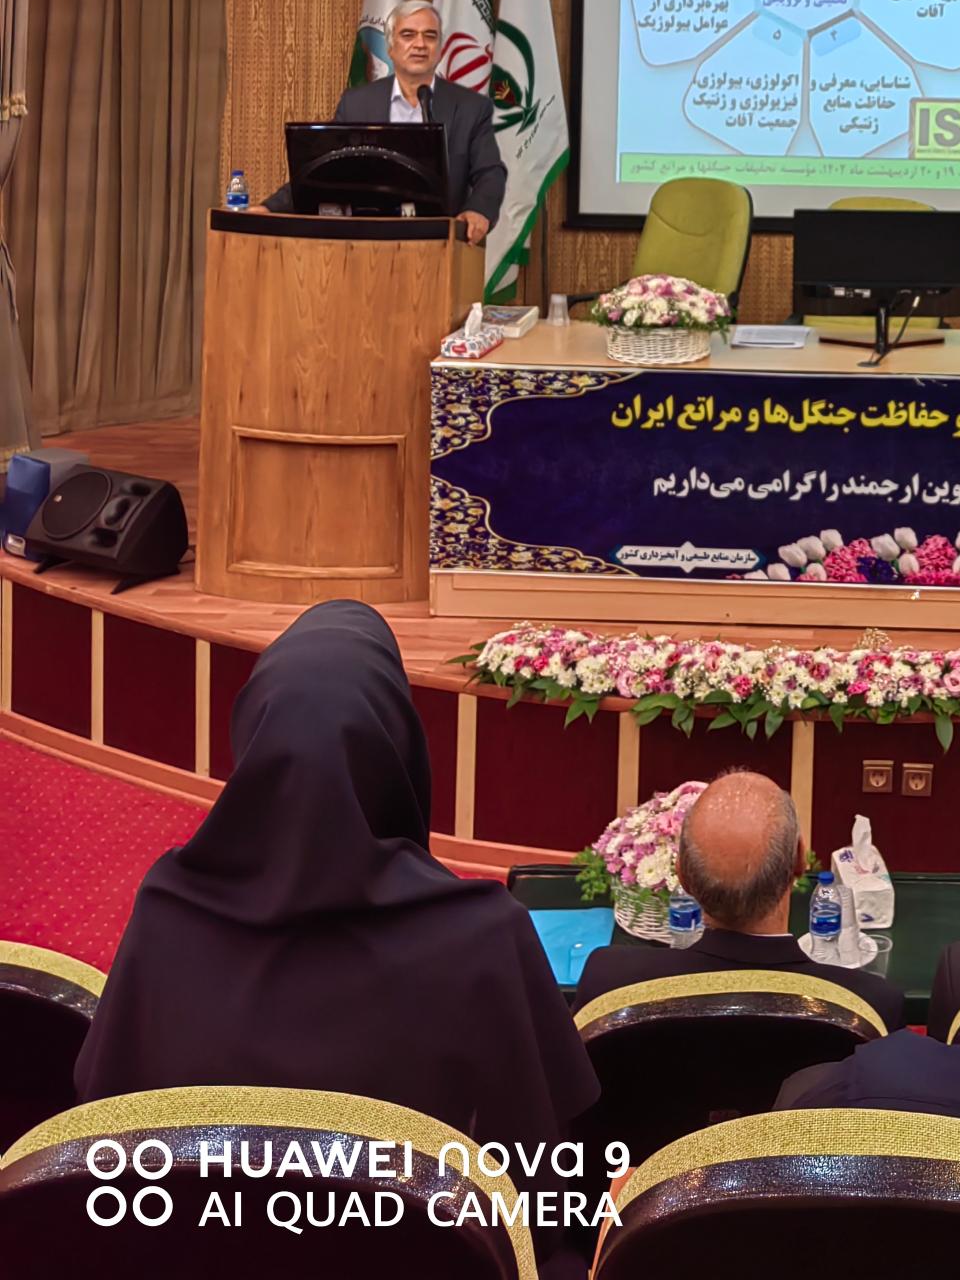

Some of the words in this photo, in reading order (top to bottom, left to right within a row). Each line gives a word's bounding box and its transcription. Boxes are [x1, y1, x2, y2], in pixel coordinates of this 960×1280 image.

[917, 4, 945, 18] آفات
[638, 16, 690, 33] بیولوژیک
[693, 17, 728, 33] عوامل
[819, 73, 857, 92] معرفی
[693, 93, 727, 110] ژنتیک
[740, 93, 798, 111] فیزیولوژی
[823, 95, 851, 112] منابع
[855, 95, 896, 109] حفاظت
[726, 113, 753, 127] آفات
[758, 115, 798, 132] جمعیت
[839, 116, 879, 134] ژنتیکی
[611, 393, 674, 428] ایران
[677, 396, 742, 431] مراتع
[765, 396, 858, 435] جنگل‌ها
[861, 400, 949, 431] حفاظت
[747, 407, 760, 432] و
[652, 465, 744, 498] می‌داریم
[747, 468, 818, 500] گرامی
[818, 471, 840, 502] را
[843, 473, 919, 504] ارجمند
[619, 549, 640, 560] کشور
[639, 549, 679, 561] آبخیزداری
[685, 551, 710, 562] طبیعی
[711, 552, 729, 563] منابع
[730, 553, 757, 564] سازمان
